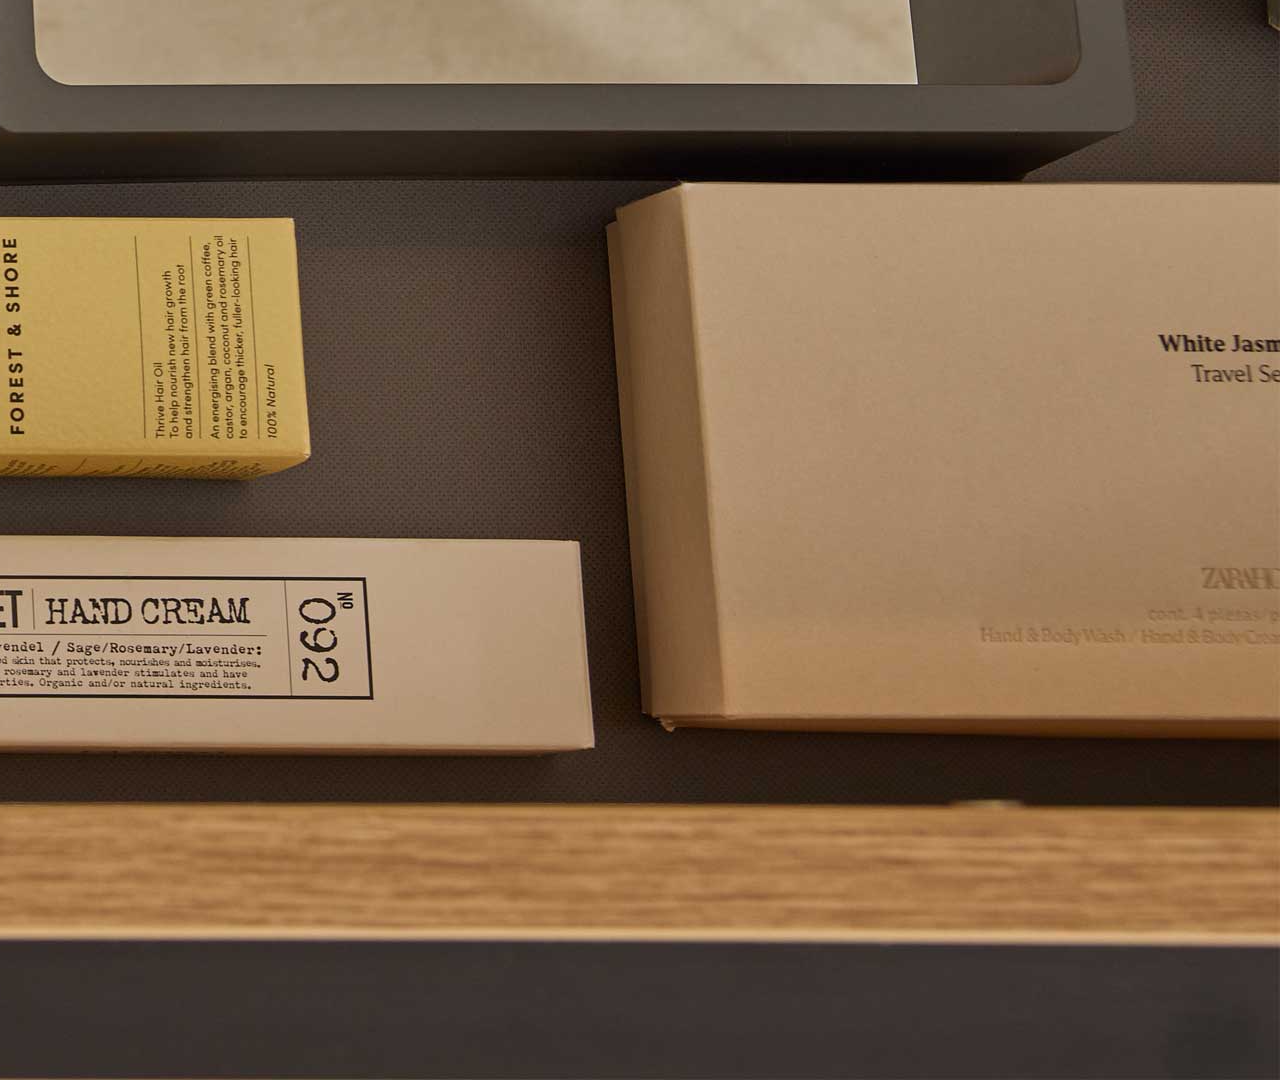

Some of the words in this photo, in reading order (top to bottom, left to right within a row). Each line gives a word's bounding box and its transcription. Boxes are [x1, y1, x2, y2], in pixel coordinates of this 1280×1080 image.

[215, 236, 223, 246] oil
[229, 239, 238, 258] hair
[202, 242, 212, 276] coffee,
[2, 238, 20, 312] SHORE
[176, 265, 185, 285] root
[217, 250, 228, 298] rosemary
[162, 271, 174, 308] growth
[177, 288, 186, 304] the
[205, 280, 215, 309] green
[230, 261, 243, 328] fuller-looking
[165, 310, 174, 331] hair
[179, 308, 188, 332] from
[205, 312, 215, 333] with
[219, 302, 228, 321] and
[7, 324, 21, 336] &
[168, 334, 176, 356] new
[180, 336, 189, 355] hair
[206, 336, 217, 365] blend
[221, 324, 231, 365] coconut
[235, 331, 245, 367] thicker,
[1158, 334, 1225, 352] White
[154, 362, 163, 377] Oil
[168, 359, 177, 397] nourish
[1191, 364, 1253, 382] Travel
[8, 348, 25, 434] FOREST
[155, 380, 164, 402] Hair
[182, 359, 193, 414] strengthen
[209, 368, 221, 422] energising
[224, 367, 234, 401] argan,
[264, 364, 276, 406] Natural
[237, 370, 248, 426] encourage
[155, 406, 165, 438] Thrive
[169, 400, 180, 423] help
[225, 405, 235, 439] castor,
[170, 426, 179, 438] To
[183, 417, 192, 438] and
[210, 425, 220, 439] An
[239, 429, 247, 438] to
[267, 411, 277, 438] 100%
[45, 597, 132, 625] HAND
[141, 598, 250, 624] CREAM
[299, 598, 339, 683] 092
[980, 626, 1022, 643] Hand
[1026, 626, 1040, 643] &
[1041, 626, 1080, 647] Body
[1082, 627, 1125, 643] Wash
[1141, 628, 1183, 644] Hand
[1186, 628, 1200, 644] &
[51, 641, 60, 655] /
[67, 642, 262, 656] Sage/Rosemary/Lavender:
[4, 668, 51, 677] rosemary
[57, 667, 76, 676] and
[81, 667, 130, 677] lavender
[134, 669, 195, 678] stimulates
[200, 670, 218, 678] and
[223, 670, 247, 678] have
[12, 657, 35, 665] skin
[40, 657, 61, 665] that
[67, 658, 115, 667] protects,
[120, 658, 170, 667] nourishes
[174, 658, 191, 667] and
[196, 659, 261, 668] moisturises.
[40, 678, 83, 688] Organic
[88, 680, 125, 689] and/or
[131, 680, 174, 689] natural
[180, 681, 252, 690] ingredients.
